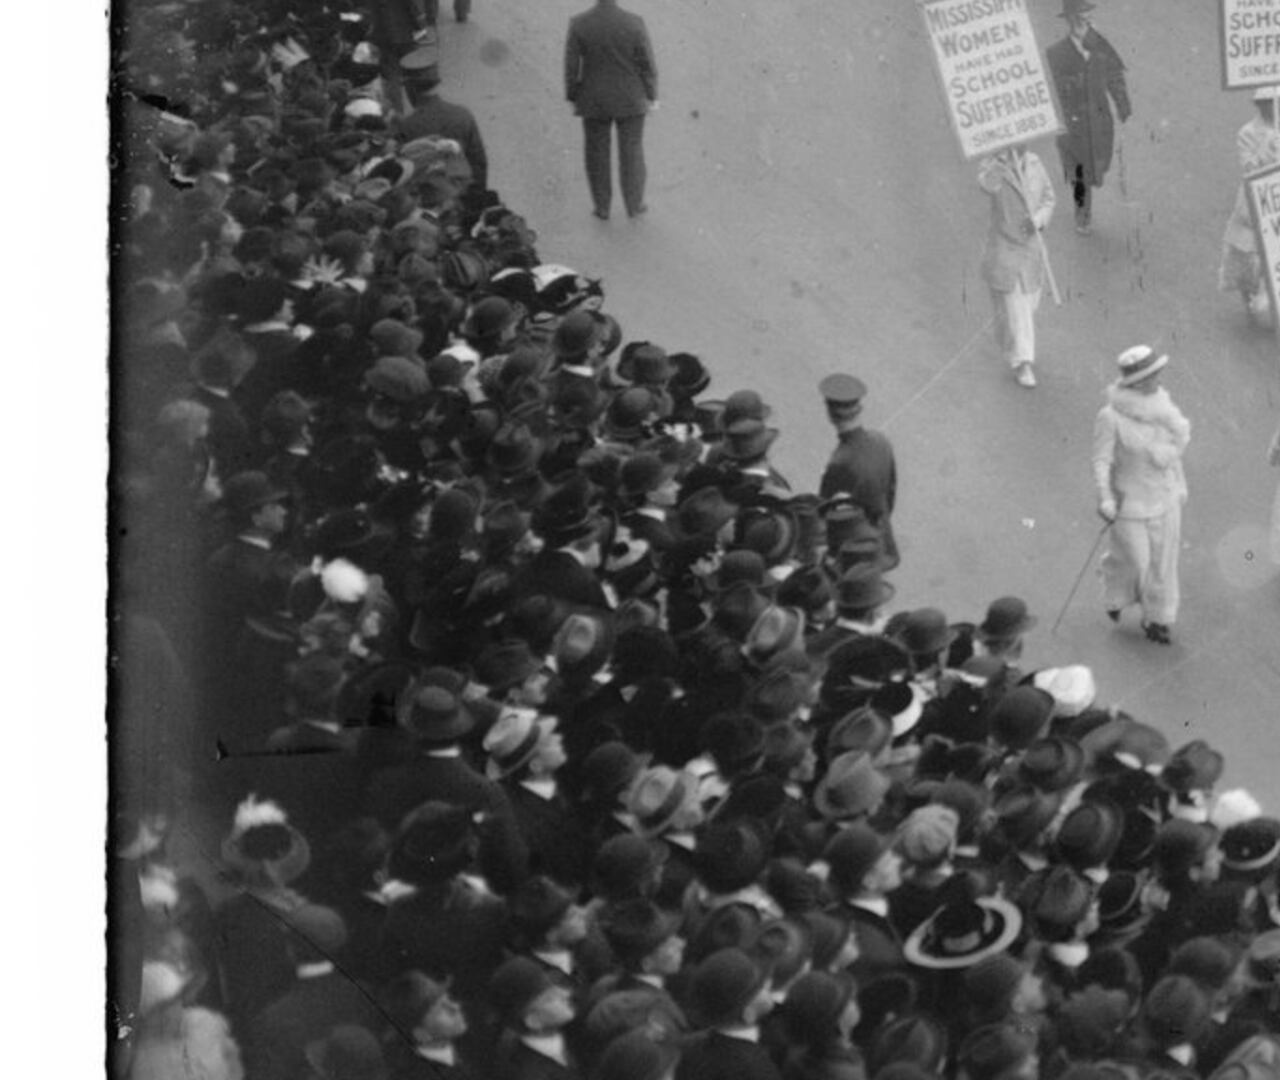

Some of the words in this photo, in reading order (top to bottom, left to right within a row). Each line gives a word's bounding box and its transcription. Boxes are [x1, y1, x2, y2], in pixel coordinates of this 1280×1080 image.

[939, 20, 1020, 58] WOMEN
[951, 61, 1038, 99] SCHOOL
[957, 81, 1048, 129] SUFFRAGE
